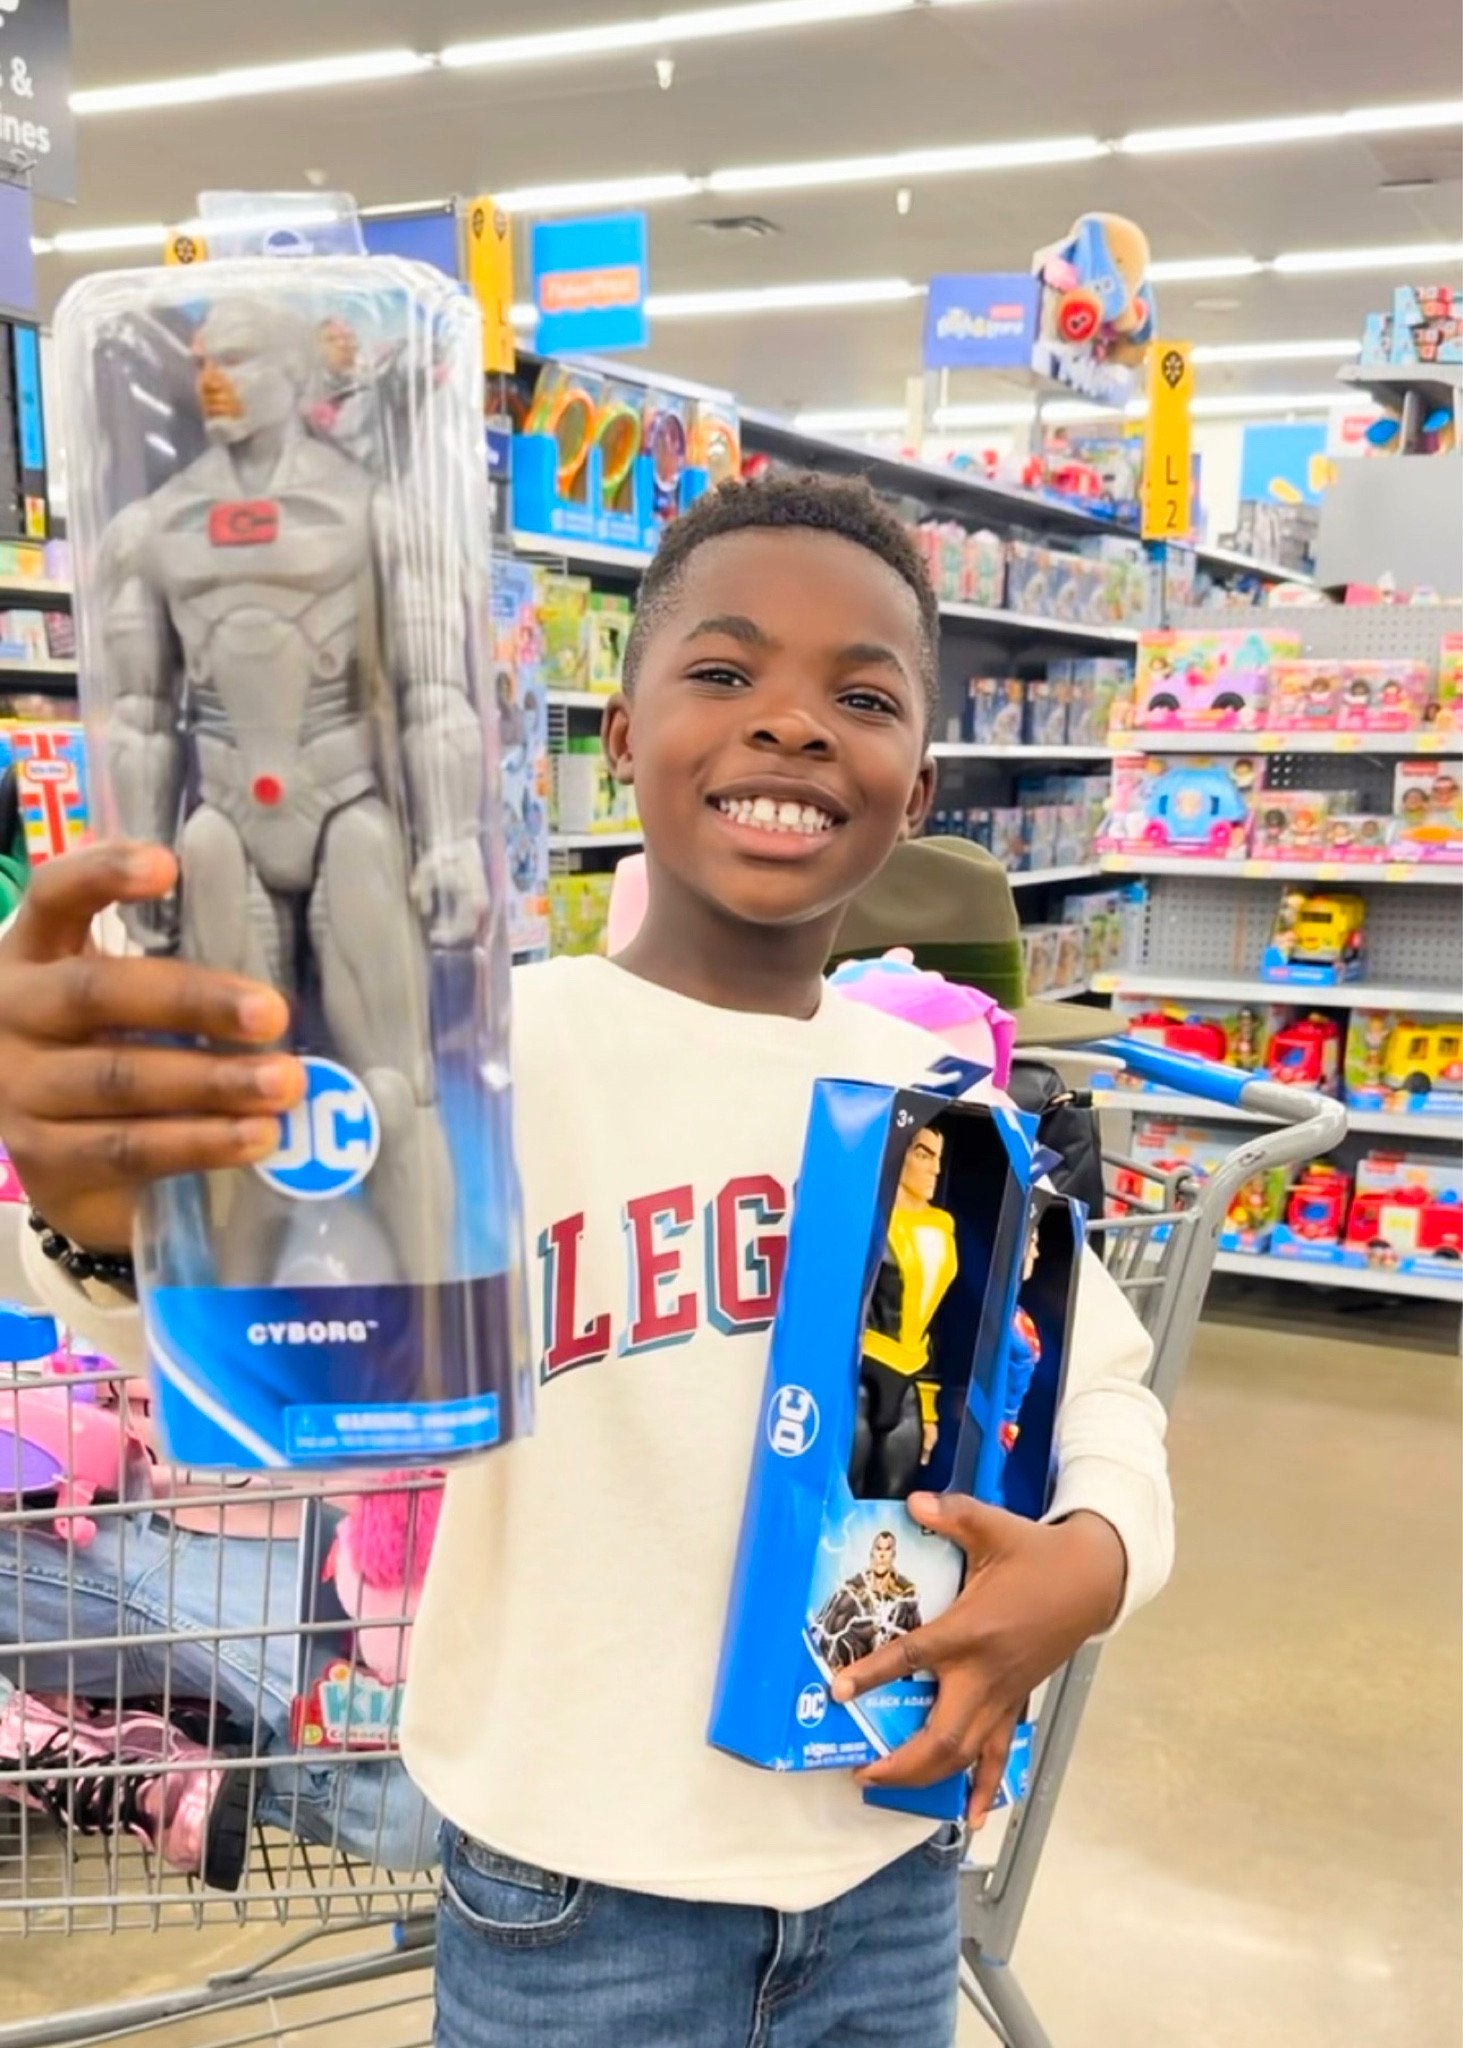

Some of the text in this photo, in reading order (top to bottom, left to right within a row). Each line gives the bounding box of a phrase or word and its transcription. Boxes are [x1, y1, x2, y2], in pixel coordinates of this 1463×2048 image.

[10, 56, 34, 98] &
[1166, 454, 1179, 486] L
[1166, 499, 1178, 529] 2
[896, 1109, 914, 1128] 3+
[538, 1174, 798, 1386] LEG
[773, 1388, 811, 1452] DC
[800, 1692, 825, 1720] DC
